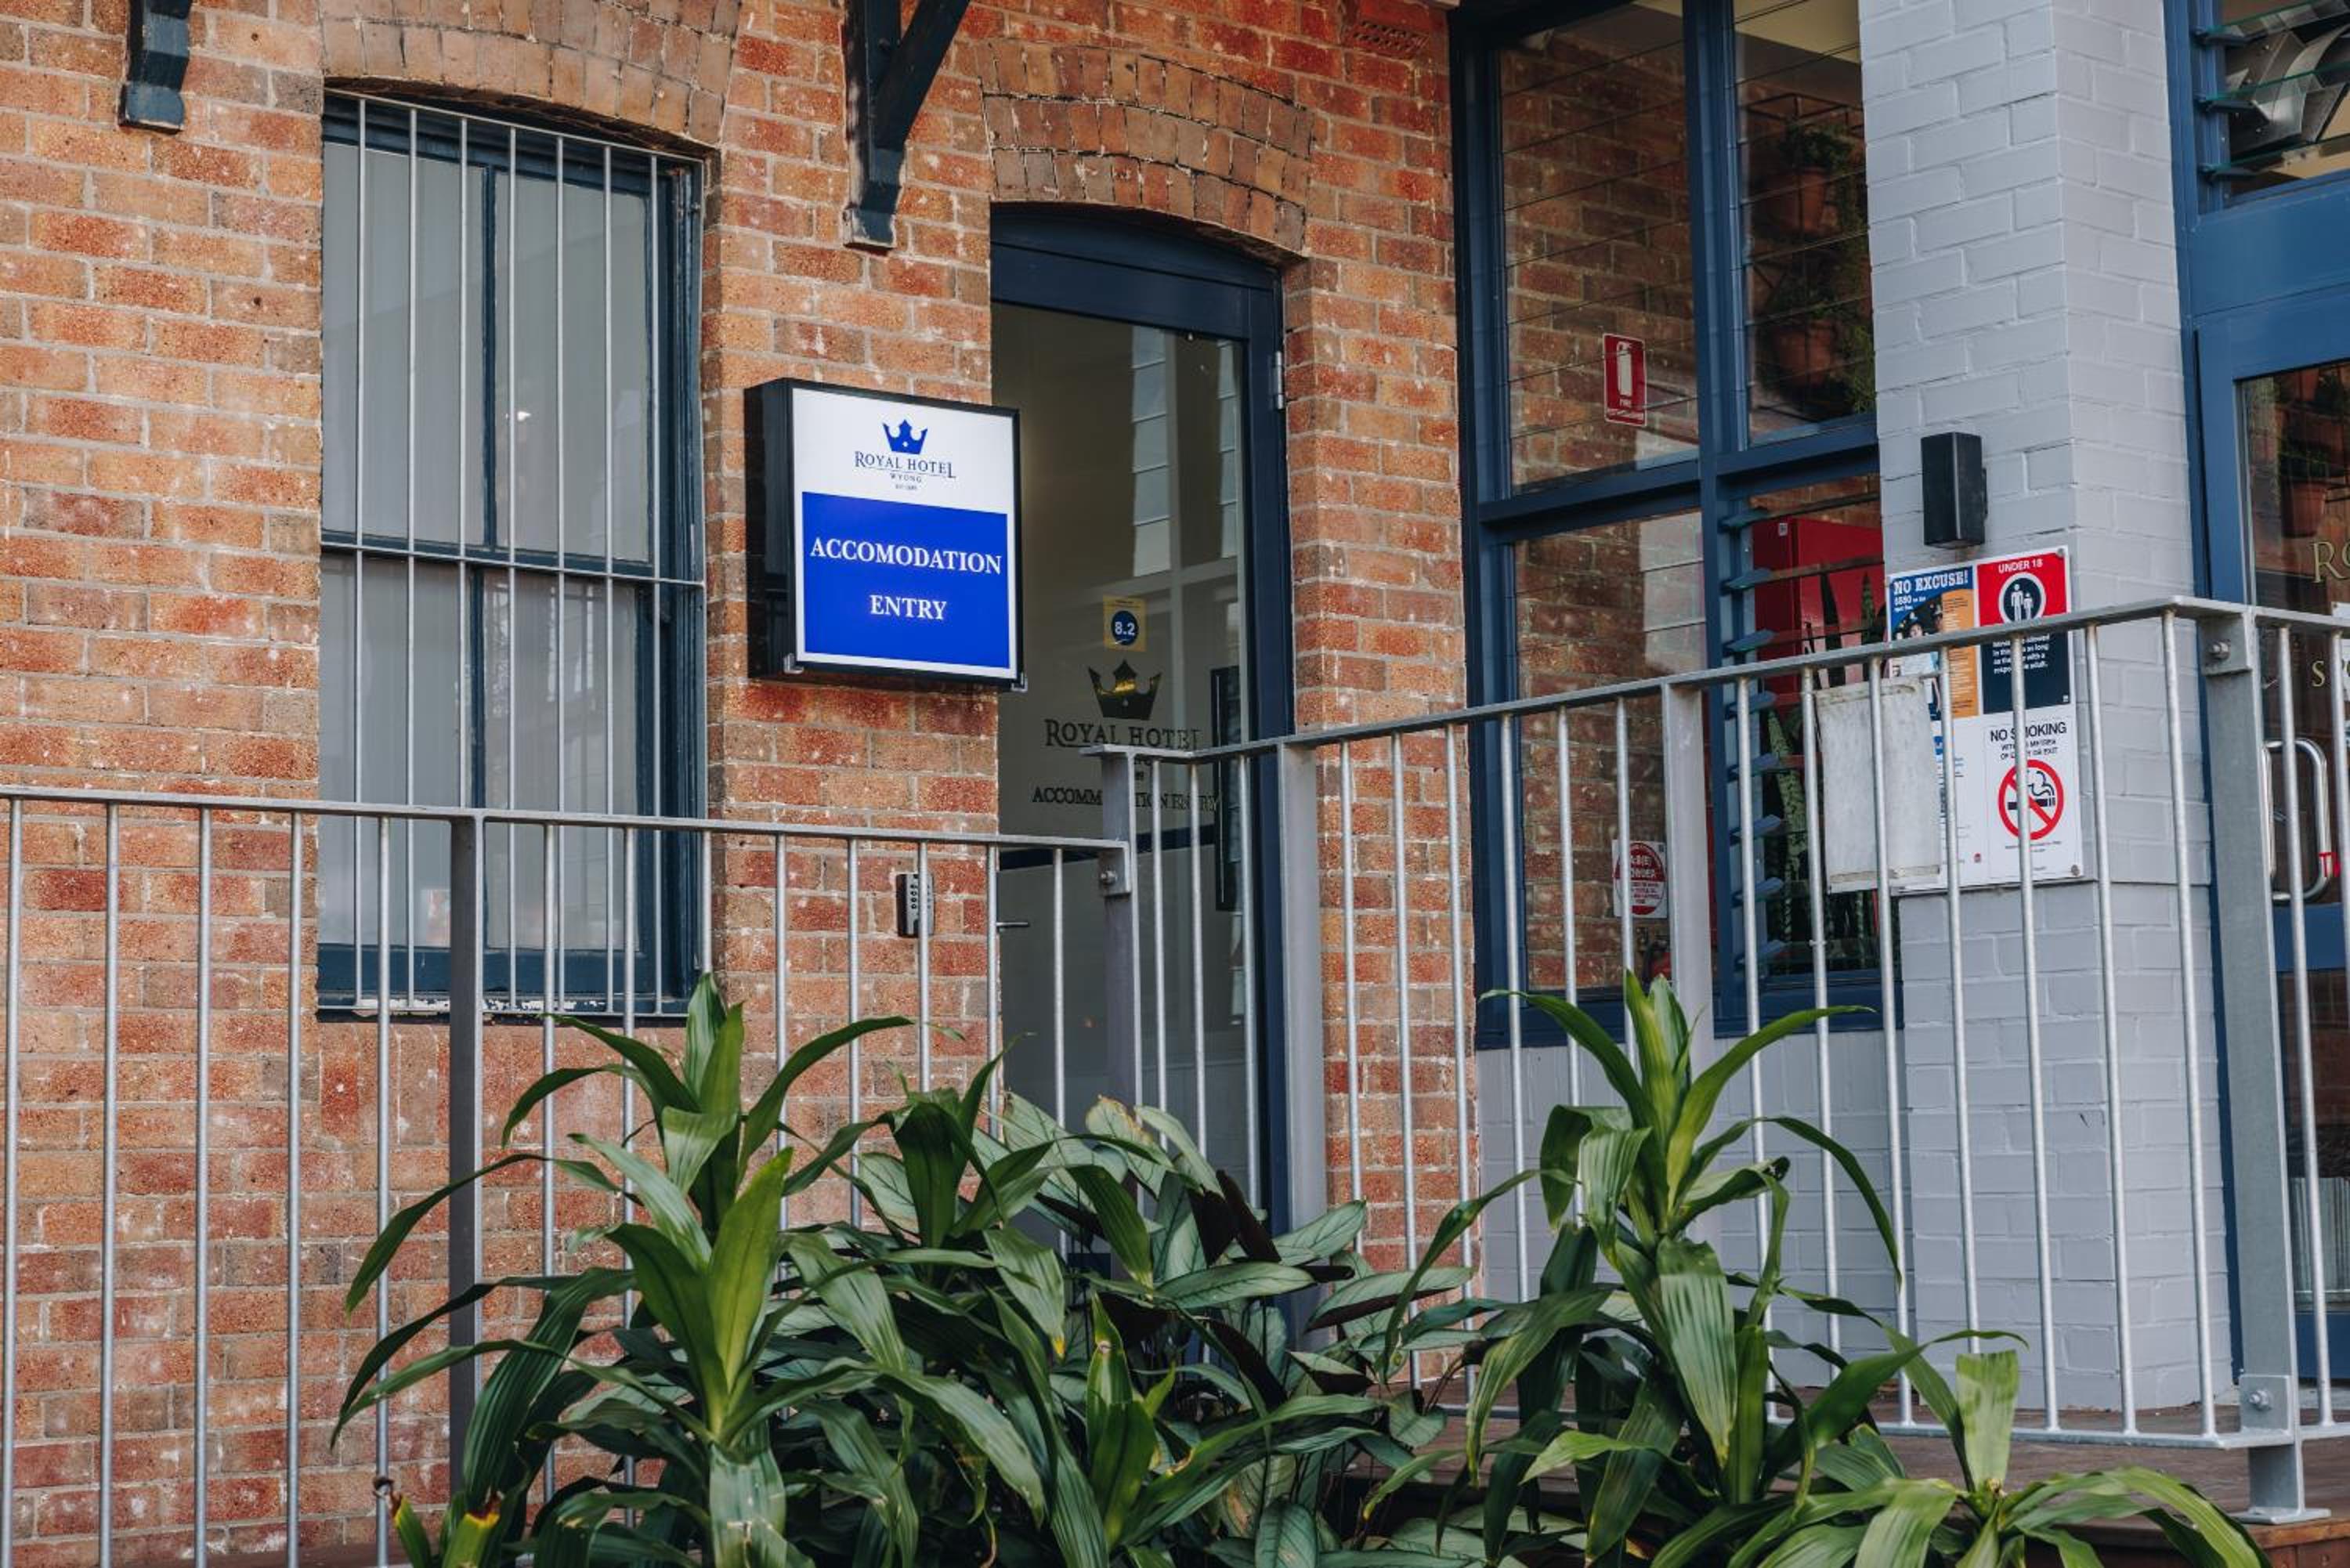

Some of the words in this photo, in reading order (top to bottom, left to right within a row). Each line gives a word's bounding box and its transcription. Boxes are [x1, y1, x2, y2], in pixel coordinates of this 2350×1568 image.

[855, 450, 902, 469] ROYAL
[908, 458, 956, 479] HOTEL
[810, 536, 1002, 575] ACCOMODATION
[1998, 560, 2030, 574] UNDER
[2031, 558, 2043, 568] 18
[1894, 579, 1911, 595] NO
[1915, 569, 1969, 591] EXCUSE!
[870, 594, 947, 620] ENTRY
[1115, 621, 1135, 635] 8.2
[1044, 718, 1120, 746] ROYAL
[1990, 729, 2008, 742] NO
[2010, 721, 2067, 740] SOKING
